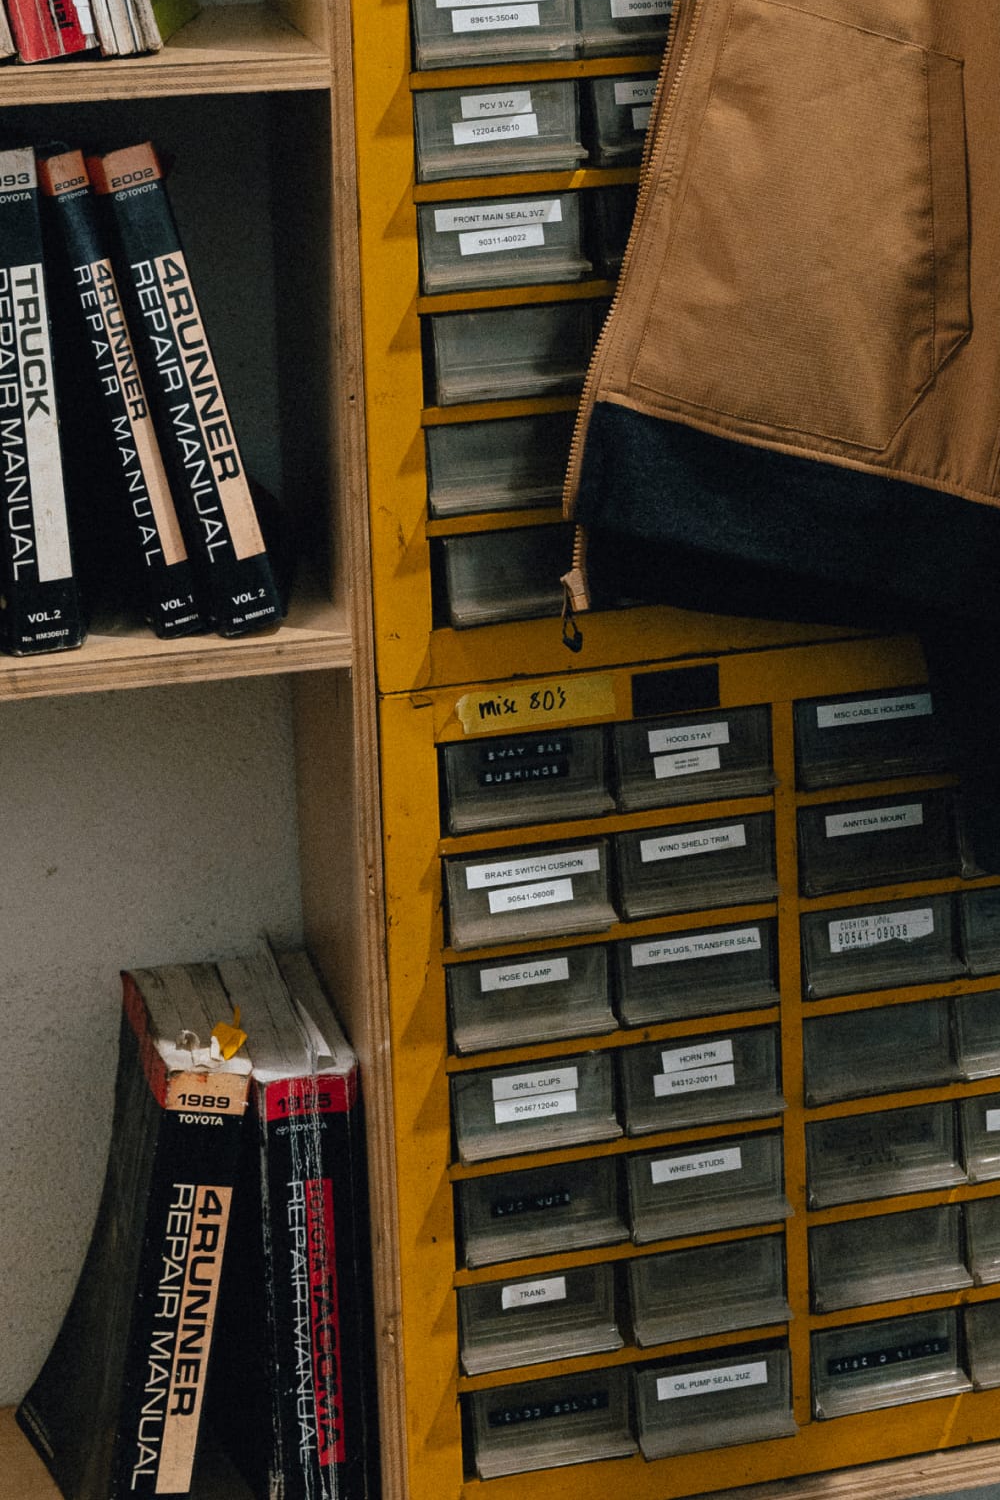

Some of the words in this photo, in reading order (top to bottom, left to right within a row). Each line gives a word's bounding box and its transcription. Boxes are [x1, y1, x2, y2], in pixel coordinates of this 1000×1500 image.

[470, 13, 519, 25] 89615-35040
[479, 101, 496, 111] PCV
[110, 167, 155, 190] 2002
[127, 183, 159, 197] TOYOTA
[453, 214, 480, 224] FRONT
[482, 212, 503, 222] MAIN
[505, 211, 527, 221] SEAL
[528, 209, 545, 218] 3VZ
[478, 233, 527, 247] 90311-40022
[13, 268, 51, 422] TRUCK
[95, 262, 148, 423] 4RUNNER
[158, 258, 242, 483] 4RUNNER
[73, 265, 121, 397] REPAIR
[111, 416, 160, 568] MANUAL
[130, 261, 183, 393] REPAIR
[168, 402, 229, 563] MANUAL
[529, 687, 567, 712] 80's
[833, 710, 851, 720] MSC
[853, 707, 878, 718] CABLE
[879, 703, 916, 715] HOLDERS
[665, 732, 689, 744] HOOD
[690, 731, 712, 742] STAY
[842, 817, 878, 829] ANNTENA
[880, 813, 907, 825] MOUNT
[658, 841, 680, 853] WIND
[681, 838, 709, 850] SHIELD
[710, 835, 730, 846] TRIM
[484, 868, 513, 880] BRAKE
[515, 865, 547, 876] SWITCH
[548, 859, 584, 873] CUSHION
[838, 924, 908, 946] 90541-09038
[498, 973, 521, 983] HOSE
[523, 968, 552, 980] CLAMP
[679, 1053, 703, 1064] HORN
[704, 1050, 717, 1061] PIN
[512, 1080, 536, 1092] GRILL
[537, 1077, 561, 1088] CLIPS
[177, 1093, 231, 1110] 1989
[178, 1114, 223, 1127] TOYOTA
[668, 1162, 698, 1174] WHEEL
[698, 1157, 726, 1169] STUDS
[154, 1183, 197, 1318] REPAIR
[169, 1188, 223, 1417] 4RUNNER
[519, 1288, 547, 1300] TRANS
[311, 1274, 341, 1455] TACOMA
[673, 1381, 688, 1392] OIL
[689, 1378, 712, 1390] PUMP
[713, 1375, 734, 1387] SEAL
[131, 1331, 175, 1491] MANUAL
